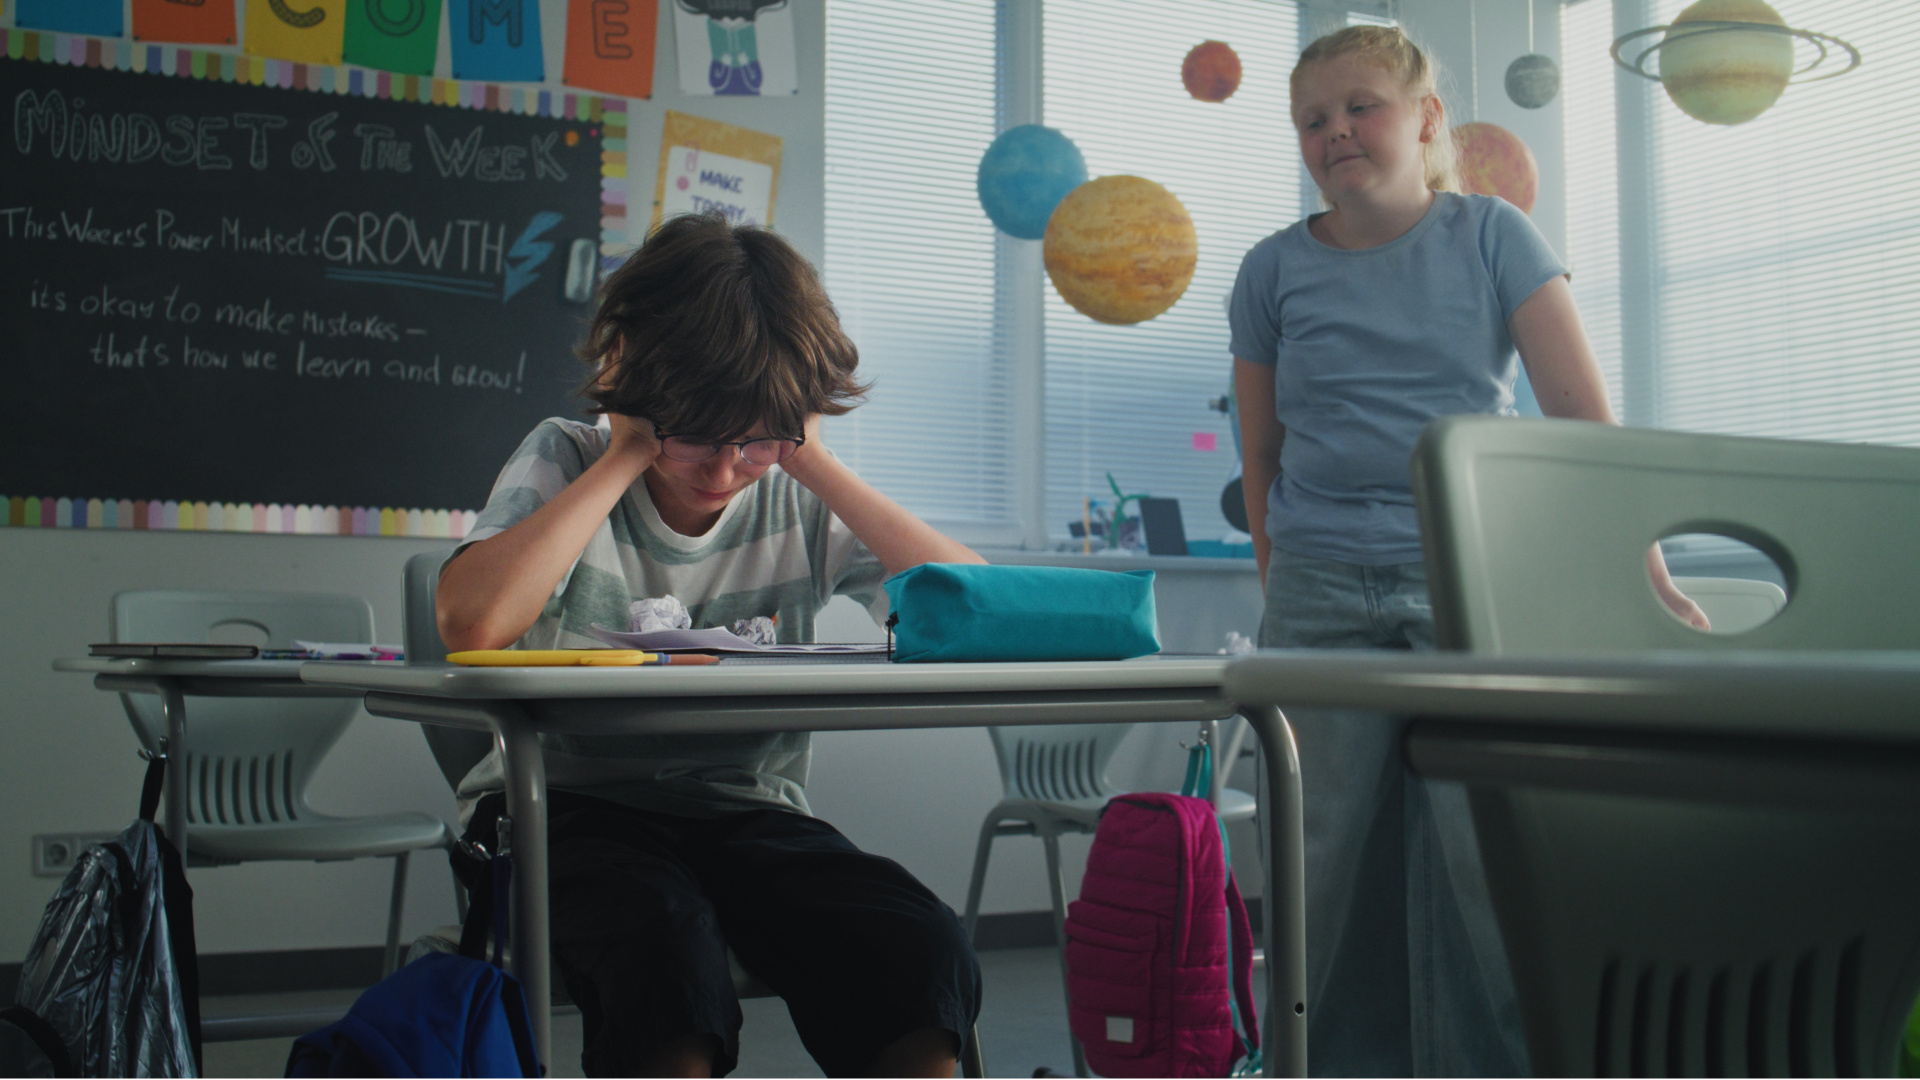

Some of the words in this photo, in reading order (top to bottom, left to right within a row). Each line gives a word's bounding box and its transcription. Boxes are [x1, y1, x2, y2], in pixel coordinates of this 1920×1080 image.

[424, 123, 568, 182] WEEK
[0, 206, 57, 239] This
[156, 208, 214, 249] Power
[322, 210, 506, 275] GROWTH
[80, 283, 155, 319] okay
[163, 283, 201, 324] to
[215, 297, 295, 335] make
[184, 335, 229, 370] how
[241, 349, 278, 371] we
[296, 339, 371, 379] learn
[383, 353, 441, 387] and
